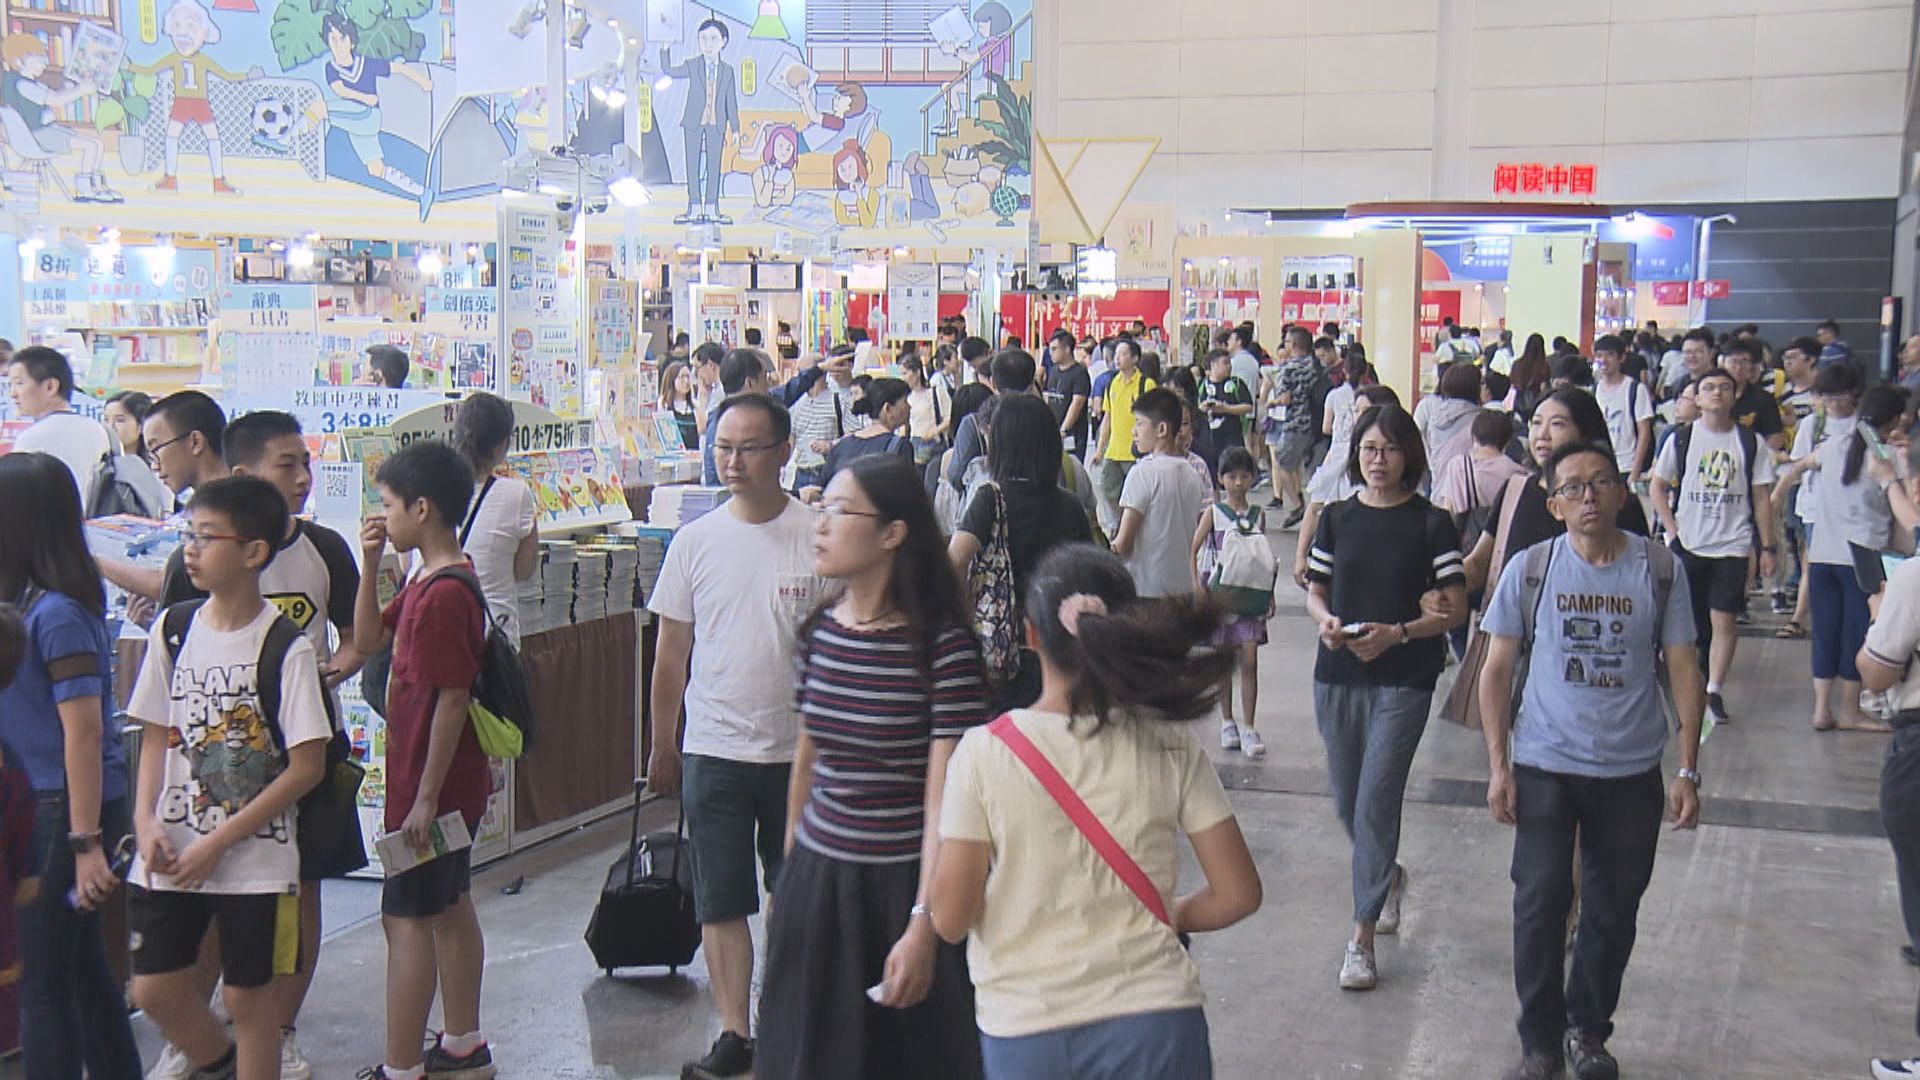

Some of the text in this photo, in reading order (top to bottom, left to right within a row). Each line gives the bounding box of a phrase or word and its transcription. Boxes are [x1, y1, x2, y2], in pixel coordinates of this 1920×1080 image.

[1494, 162, 1596, 195] 阅读中国
[443, 294, 497, 312] 劍橋英
[1556, 593, 1633, 616] CAMPING
